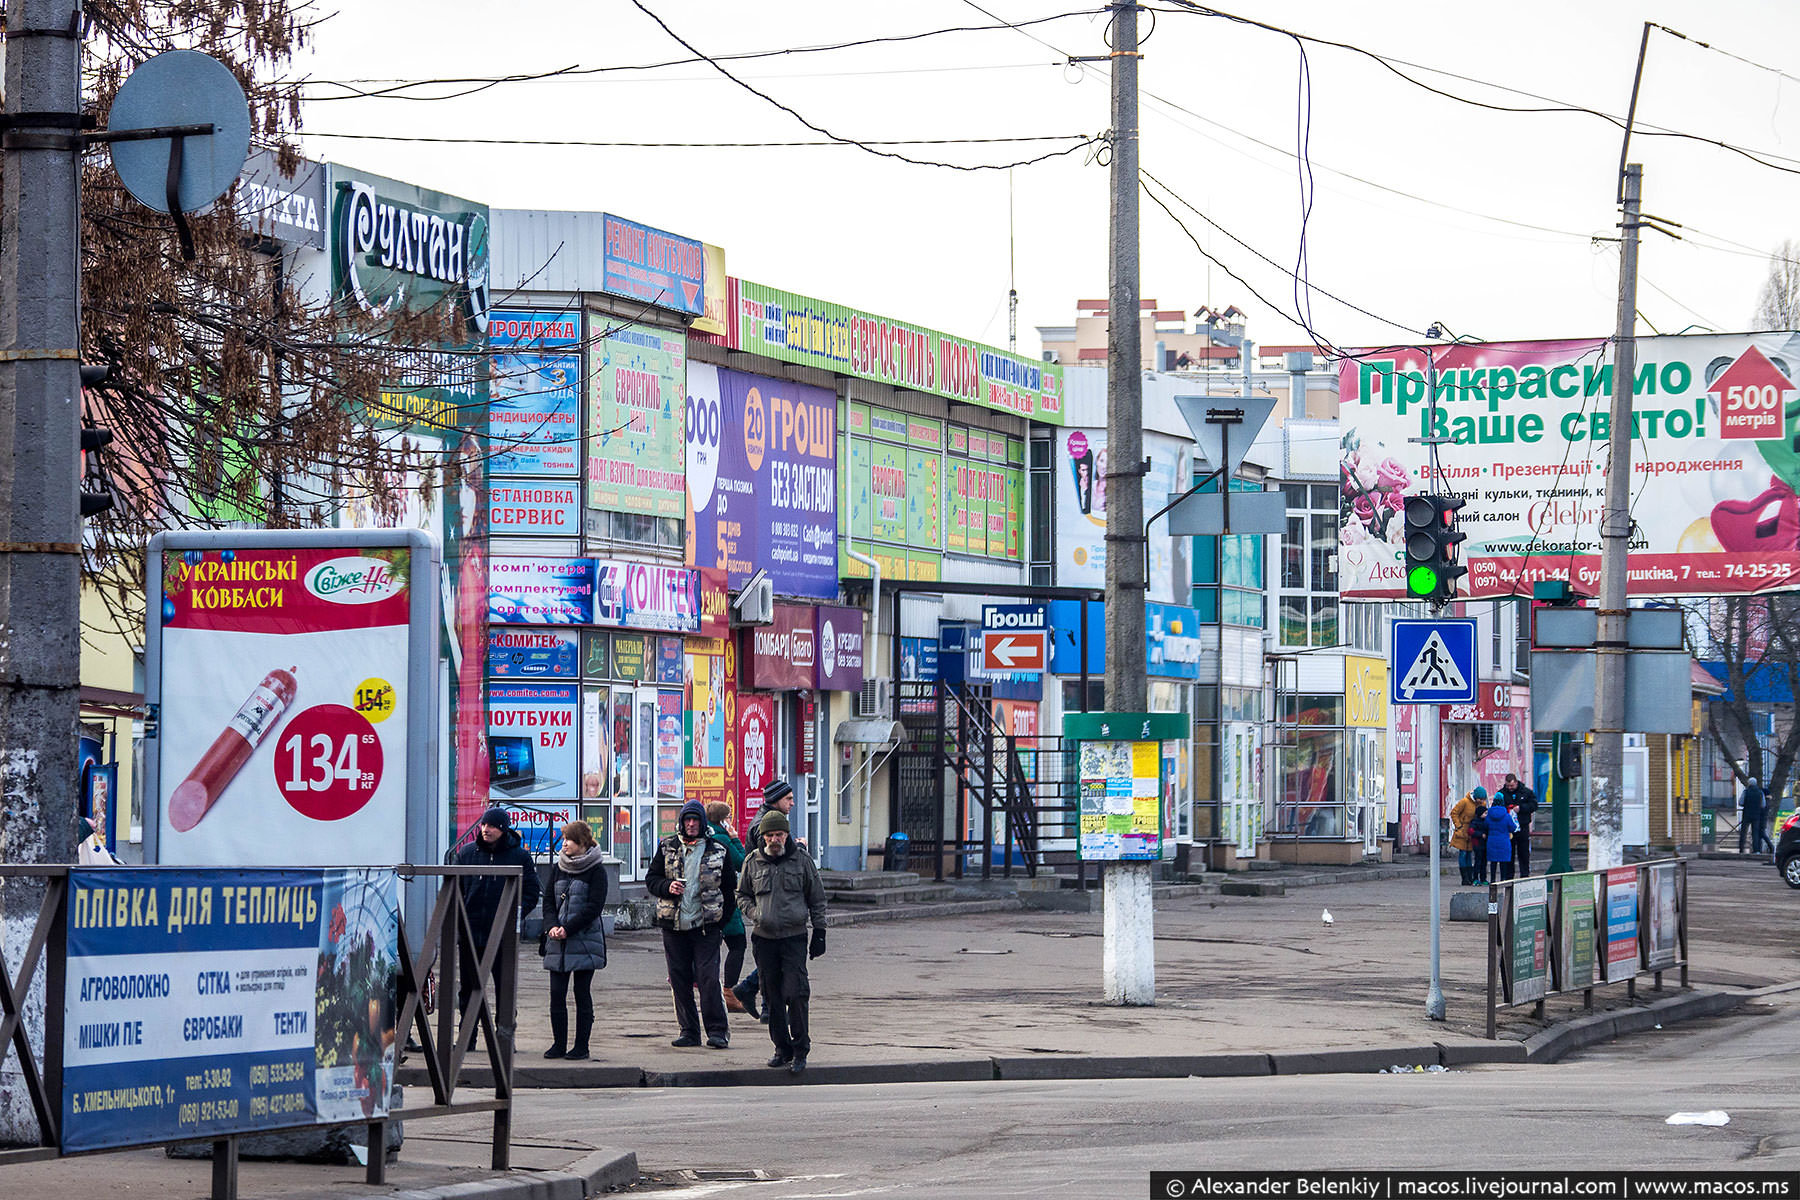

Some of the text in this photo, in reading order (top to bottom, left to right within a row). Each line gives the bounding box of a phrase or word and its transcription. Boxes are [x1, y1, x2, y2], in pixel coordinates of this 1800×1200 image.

[606, 219, 701, 281] РЕМОНТ НОУТБУКОВ
[850, 314, 935, 390] ЄВРОСТИЛЬ
[550, 368, 567, 386] 3
[1359, 360, 1692, 415] Прикрасимо
[541, 386, 575, 400] ГОДА
[1727, 385, 1778, 411] 500
[747, 406, 763, 441] 20
[770, 397, 833, 460] ГРОШІ
[1420, 398, 1706, 447] Ваше свто!
[1726, 411, 1776, 430] метрів
[543, 461, 575, 469] TOSHIBA
[696, 451, 707, 465] ГРН
[1492, 459, 1593, 481] Презентації
[1634, 459, 1744, 477] народження
[717, 476, 754, 496] ПЕРША ПОЗИКА
[771, 460, 790, 509] БЕЗ
[791, 463, 834, 514] ЗАСТАВИ
[1484, 488, 1532, 505] кульки,
[1536, 486, 1593, 501] тканини,
[717, 493, 728, 516] ДО
[491, 507, 565, 526] СЕРВИС
[1483, 511, 1520, 522] салон
[727, 521, 741, 538] ДНІВ
[775, 522, 783, 536] 800
[802, 524, 834, 549] Cash point
[716, 520, 728, 570] 5
[771, 545, 799, 564] cashpoint.ua
[179, 555, 297, 583] УКРАЇНСЬКІ
[1473, 561, 1497, 574] (050)
[1474, 568, 1570, 589] (097) 44-111-44
[1681, 565, 1691, 579] 7
[1696, 569, 1721, 579] тел.:
[1724, 563, 1792, 579] 74-25-25
[192, 585, 284, 609] КОВБАСИ
[625, 564, 698, 616] КОМІТЕК
[705, 586, 727, 616] ЗАЙМ
[496, 604, 582, 617] оргтехніка
[984, 607, 1044, 629] Гроші
[489, 633, 565, 649] «КОМИТЕК»
[754, 632, 812, 660] ЛОМБАРД Благо
[356, 688, 383, 712] 154
[361, 734, 375, 744] 65
[540, 731, 568, 749] Б/У
[285, 733, 362, 792] 134
[361, 773, 375, 781] за
[361, 781, 374, 790] кг
[74, 886, 317, 934] ПЛІВКА ДЛЯ ТЕПЛИЦЬ
[80, 971, 231, 1002] АГРОВОЛОКНО СІТКА
[79, 1011, 308, 1049] МІШКИ П/Е ЄВРОБАКИ ТЕНТИ
[72, 1092, 82, 1114] Б.
[83, 1085, 164, 1112] ХМЕЛЬНИЦЬКОГО,
[178, 1103, 200, 1128] (068)
